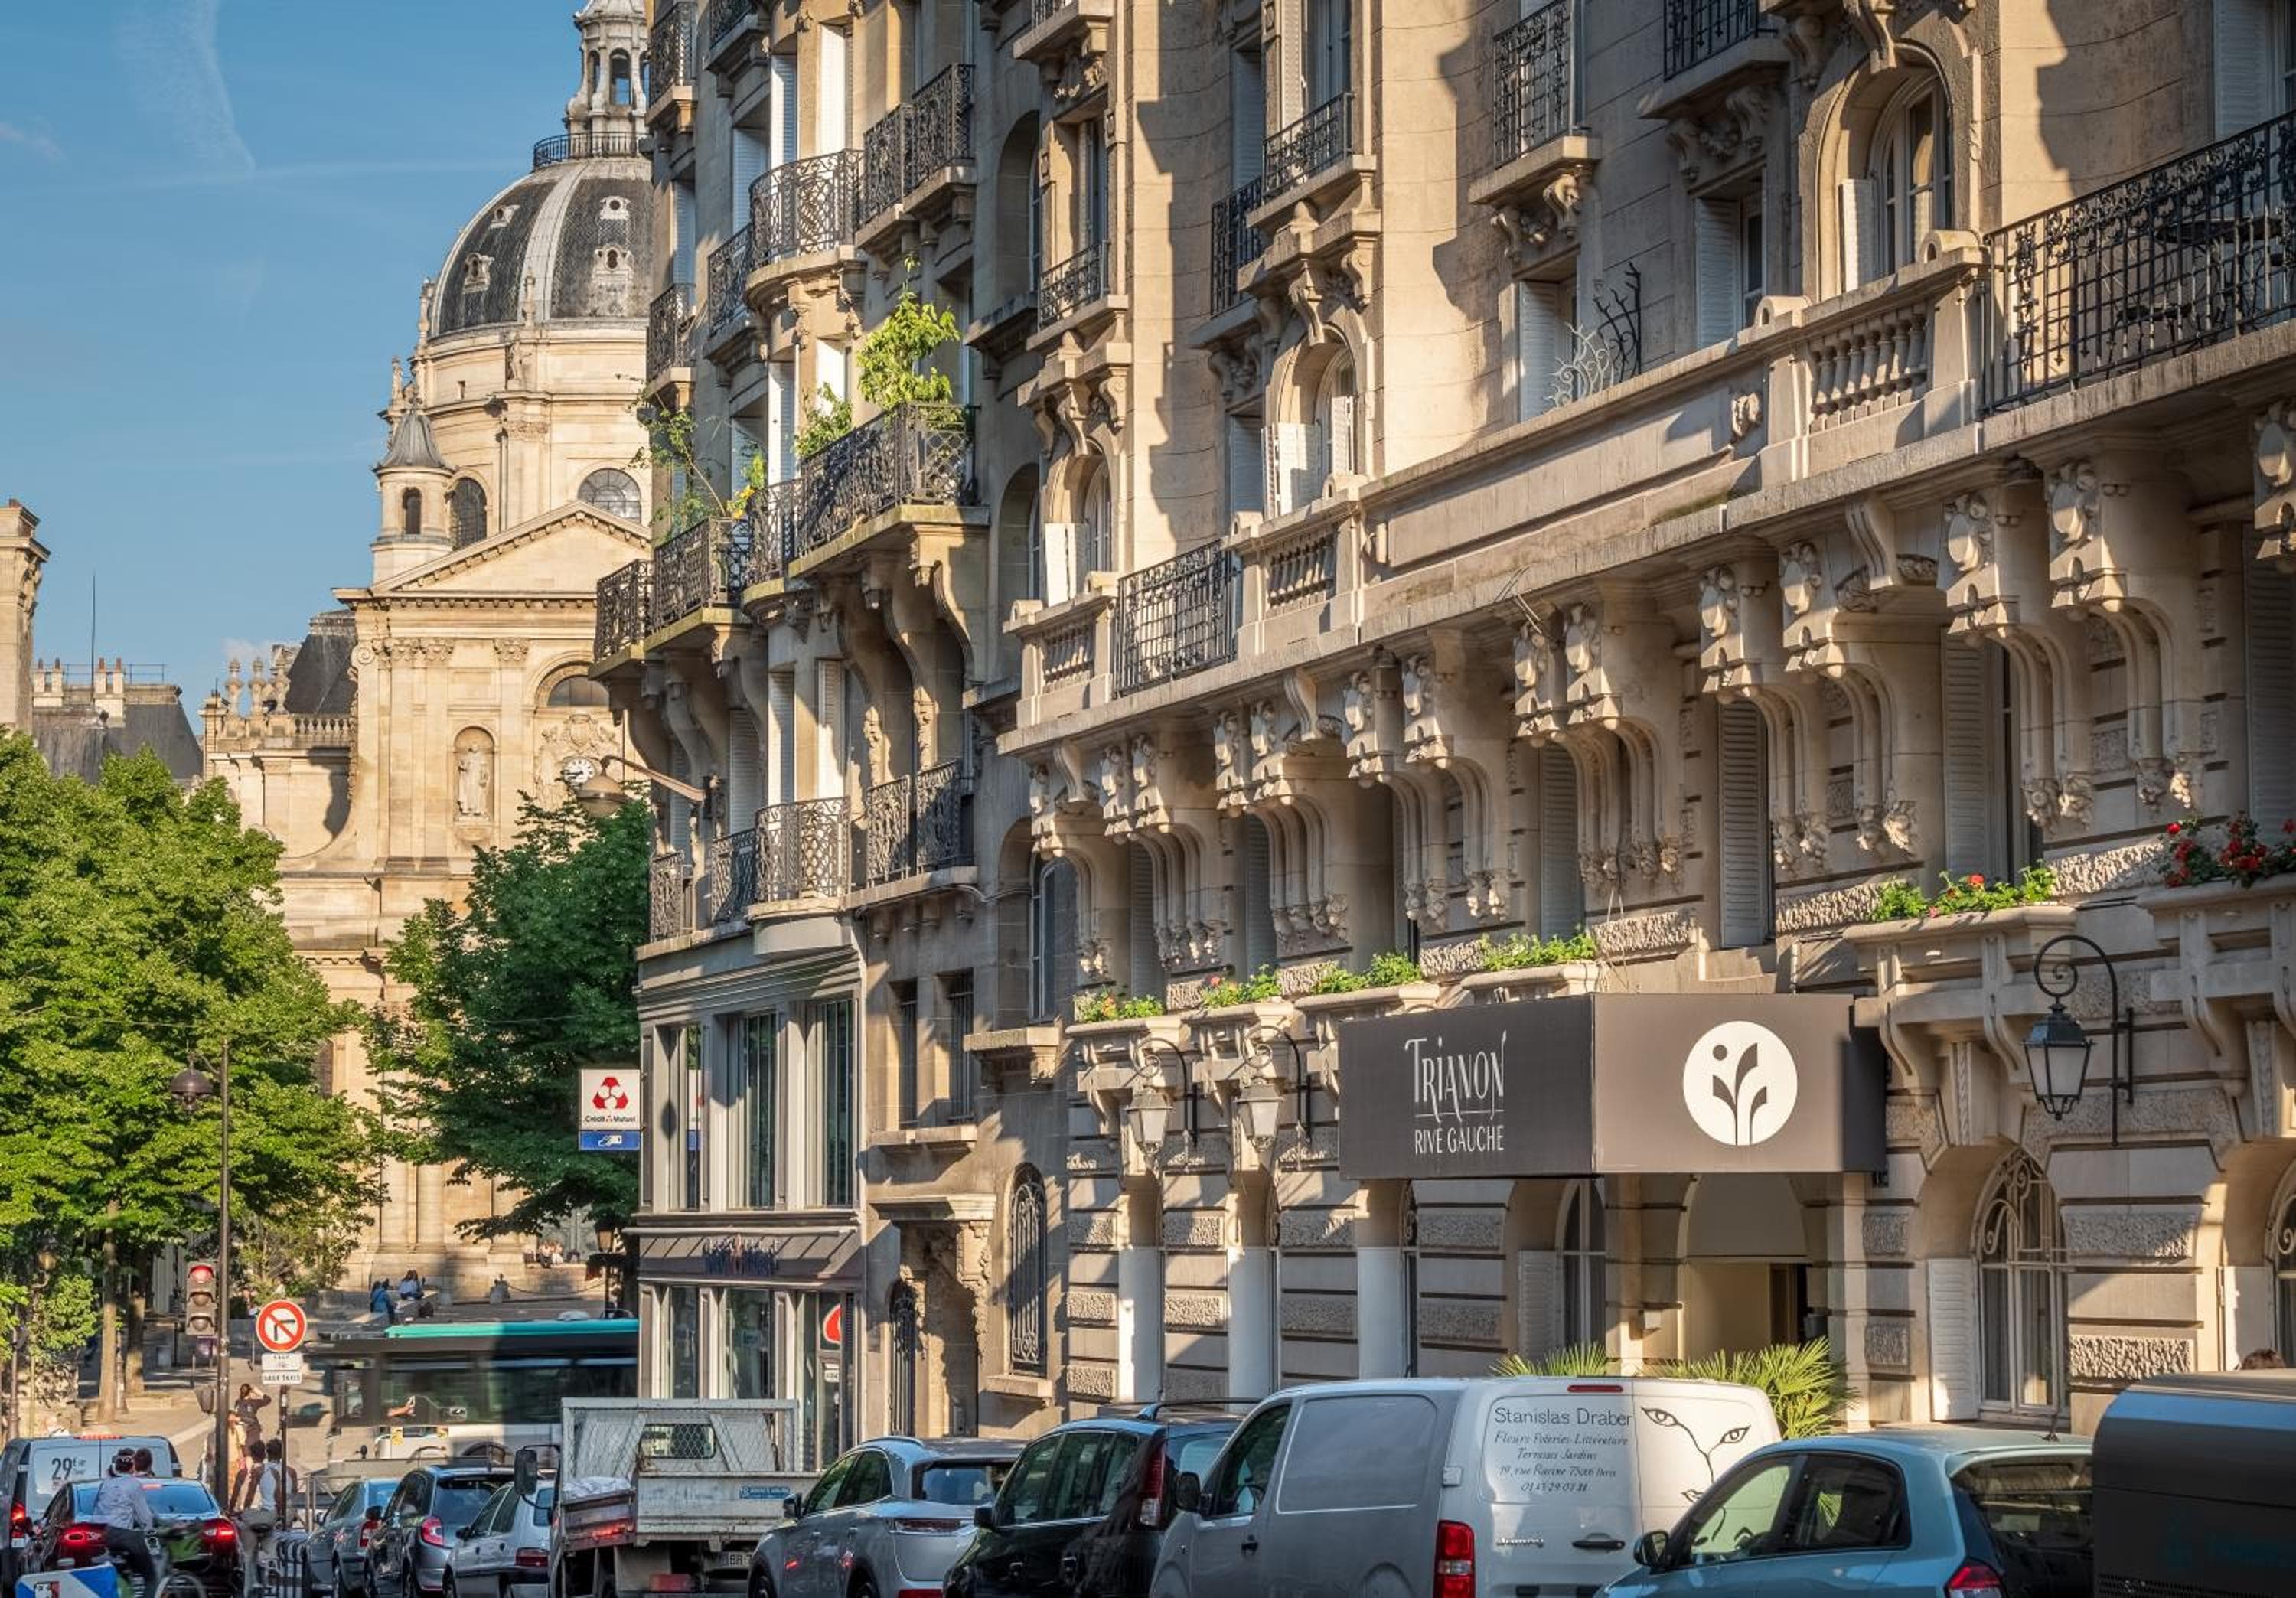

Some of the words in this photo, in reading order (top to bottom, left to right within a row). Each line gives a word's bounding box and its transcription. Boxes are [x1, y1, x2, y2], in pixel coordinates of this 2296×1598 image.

[1415, 1128, 1443, 1155] RIVE
[1447, 1125, 1504, 1153] GAUCHE
[1495, 1407, 1570, 1424] Stanislas
[1577, 1407, 1632, 1426] Draber
[51, 1457, 73, 1480] 29
